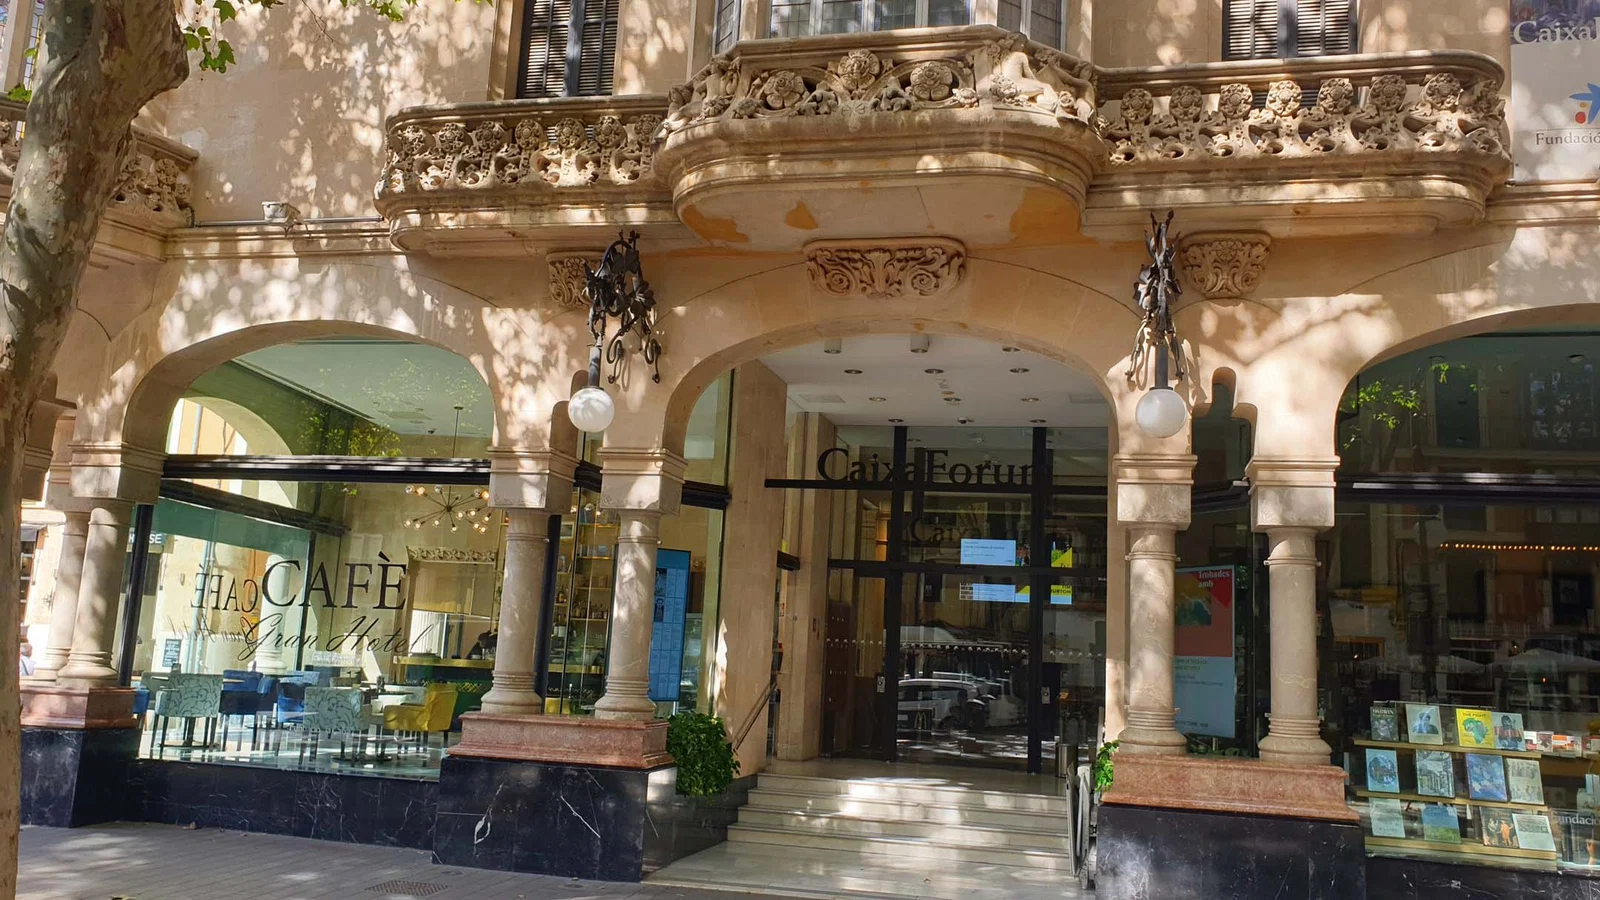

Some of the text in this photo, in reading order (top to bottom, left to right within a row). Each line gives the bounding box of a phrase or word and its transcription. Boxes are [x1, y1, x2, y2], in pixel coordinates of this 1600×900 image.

[262, 550, 407, 611] CAFÈ
[237, 613, 434, 662] Gran Hotel
